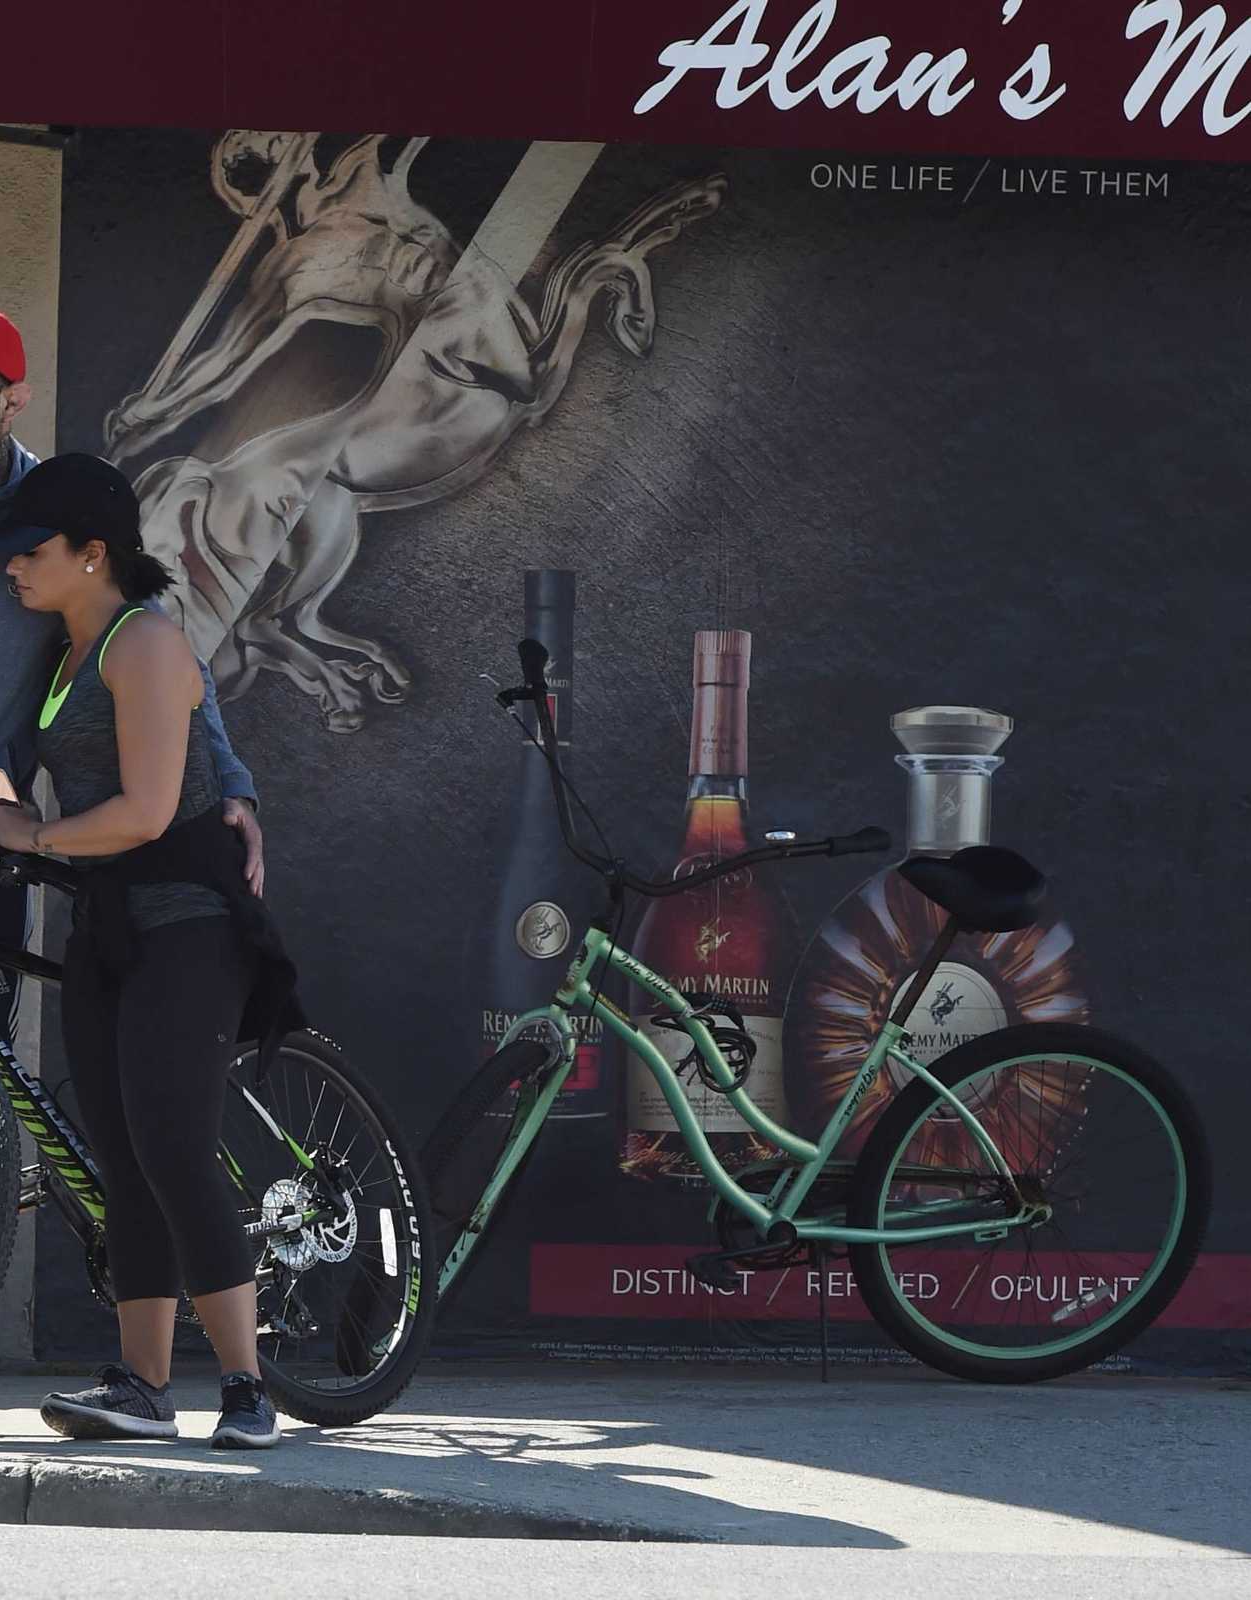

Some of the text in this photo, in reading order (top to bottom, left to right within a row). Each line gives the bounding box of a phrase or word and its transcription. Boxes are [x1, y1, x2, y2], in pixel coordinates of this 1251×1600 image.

[634, 0, 1066, 121] Alan's
[811, 163, 877, 189] ONE
[891, 167, 954, 191] LIFE
[1001, 168, 1067, 195] LIVE
[1080, 171, 1168, 198] THEM
[704, 973, 770, 996] MARTIN
